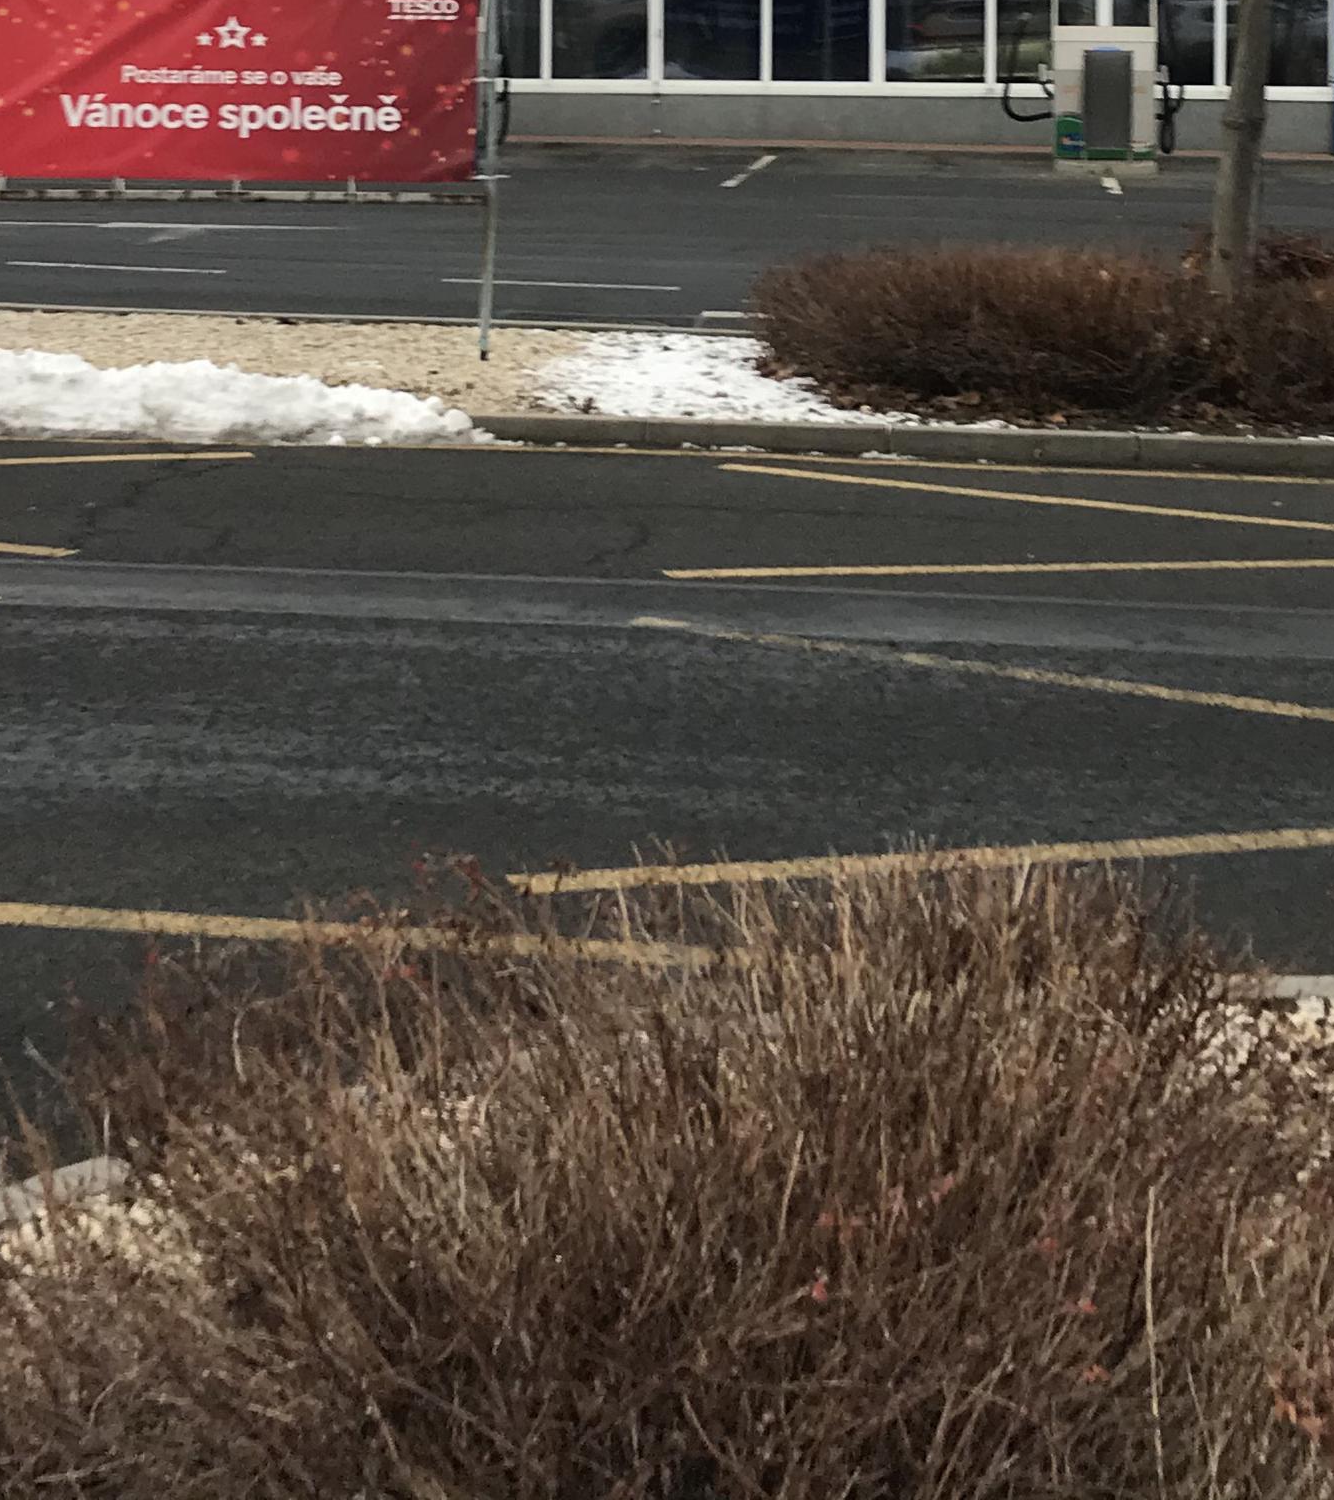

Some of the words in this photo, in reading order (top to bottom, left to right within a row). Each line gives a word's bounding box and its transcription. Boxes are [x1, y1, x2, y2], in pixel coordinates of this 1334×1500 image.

[120, 65, 237, 85] Postaráme
[240, 69, 267, 86] se
[270, 70, 288, 86] o
[291, 65, 343, 87] vaše
[59, 93, 210, 130] Vánoce
[218, 94, 402, 138] společně
